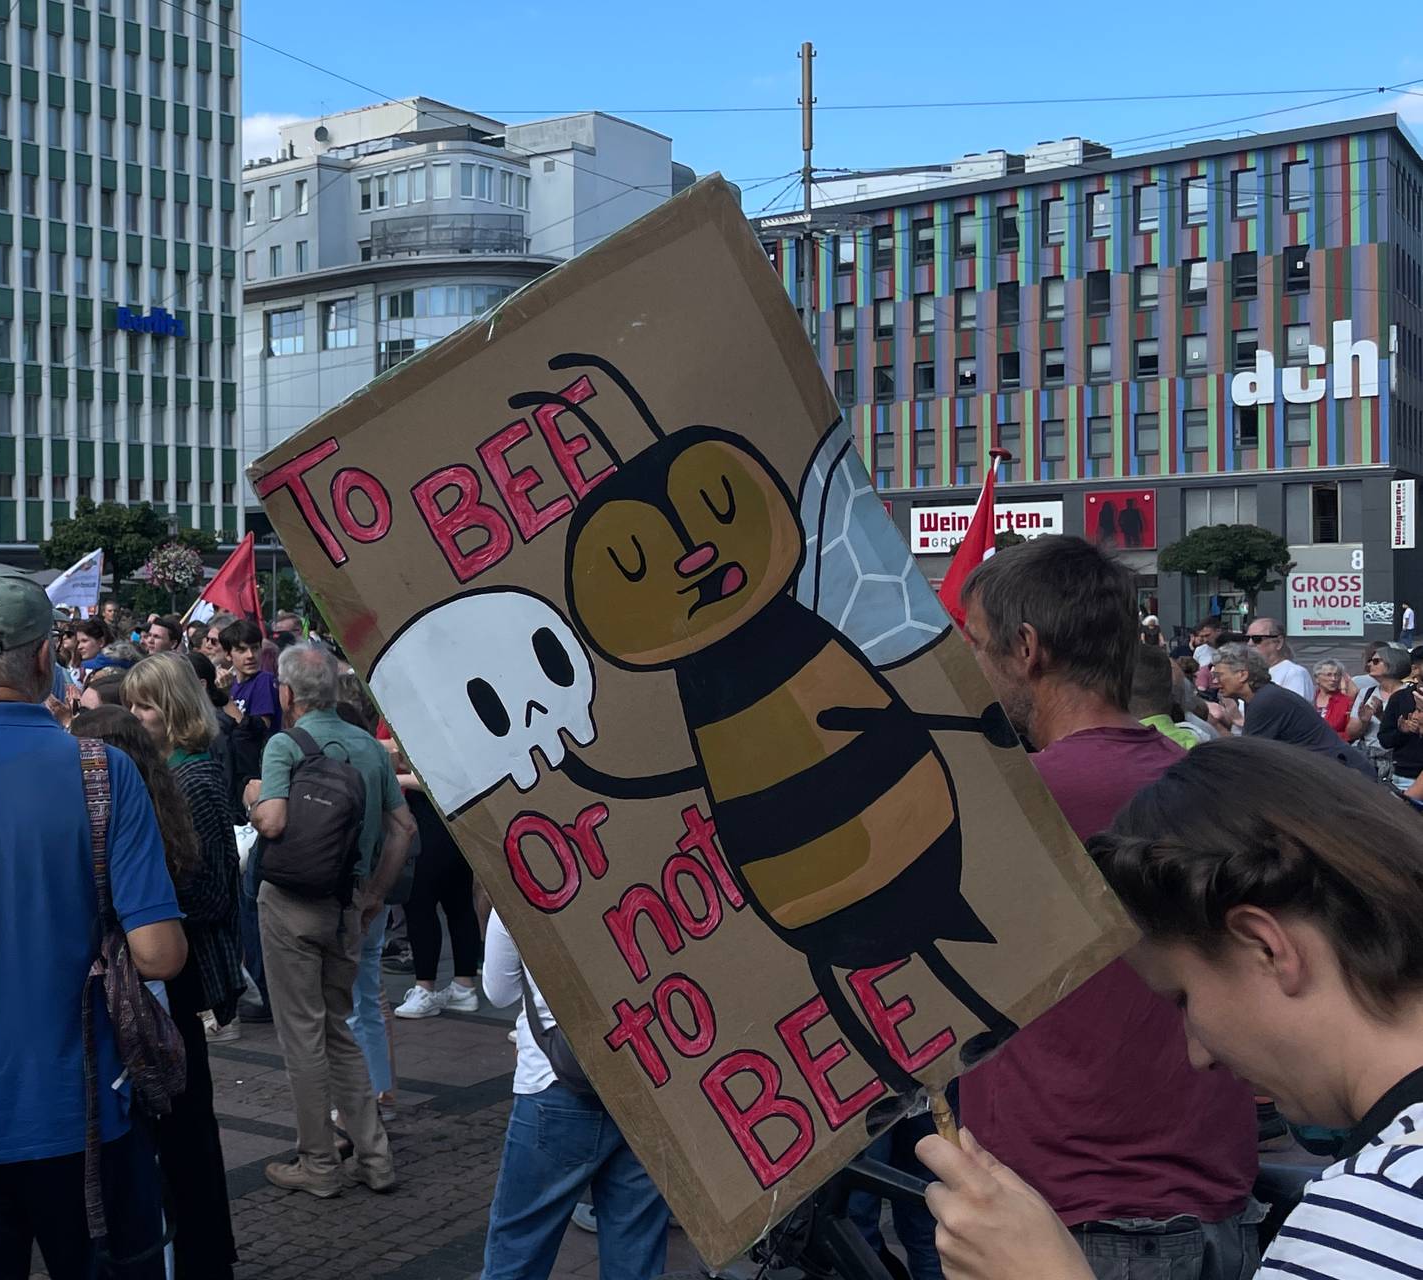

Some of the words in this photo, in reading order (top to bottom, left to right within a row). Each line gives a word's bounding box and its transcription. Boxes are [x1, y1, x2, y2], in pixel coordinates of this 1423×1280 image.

[410, 374, 620, 585] BEE
[919, 511, 1041, 532] Weinrten
[1351, 550, 1364, 570] 8
[1291, 575, 1362, 593] GROSS
[1293, 595, 1308, 608] in
[1312, 595, 1362, 608] MODE
[602, 804, 746, 984] not
[700, 955, 958, 1191] BEE
